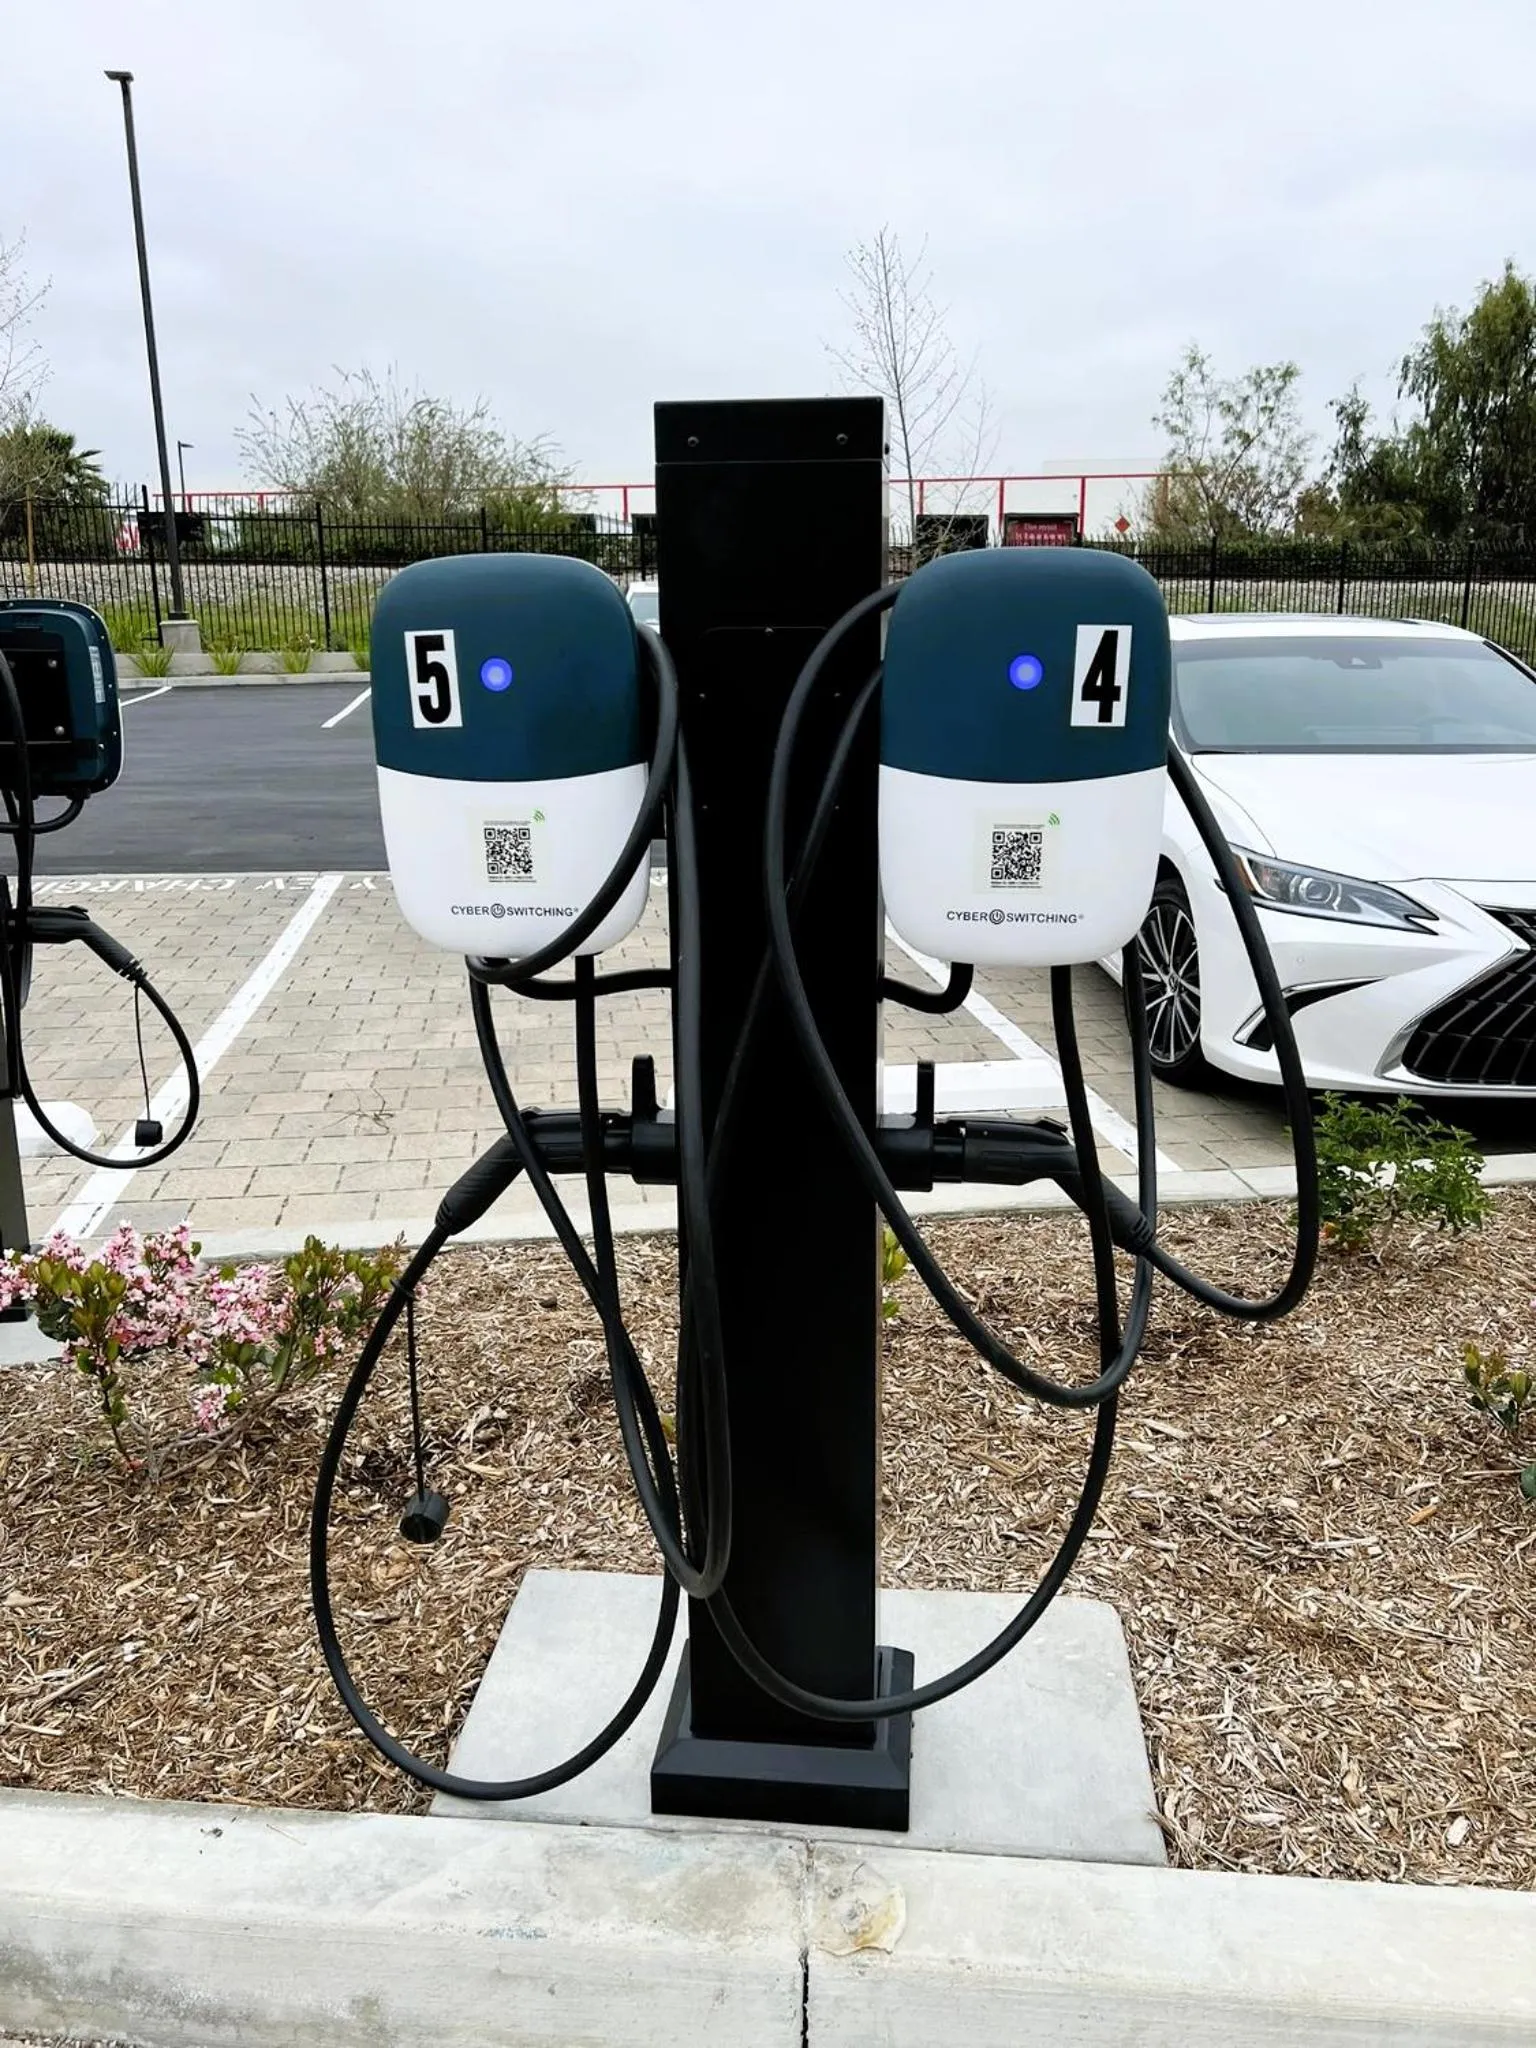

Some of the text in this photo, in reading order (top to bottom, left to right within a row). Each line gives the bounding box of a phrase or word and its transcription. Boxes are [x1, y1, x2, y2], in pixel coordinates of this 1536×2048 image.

[414, 634, 452, 724] 5
[1081, 630, 1121, 723] 4
[450, 905, 574, 917] CYBER SWITCHING
[946, 910, 1078, 924] CYBER SWITCHING
